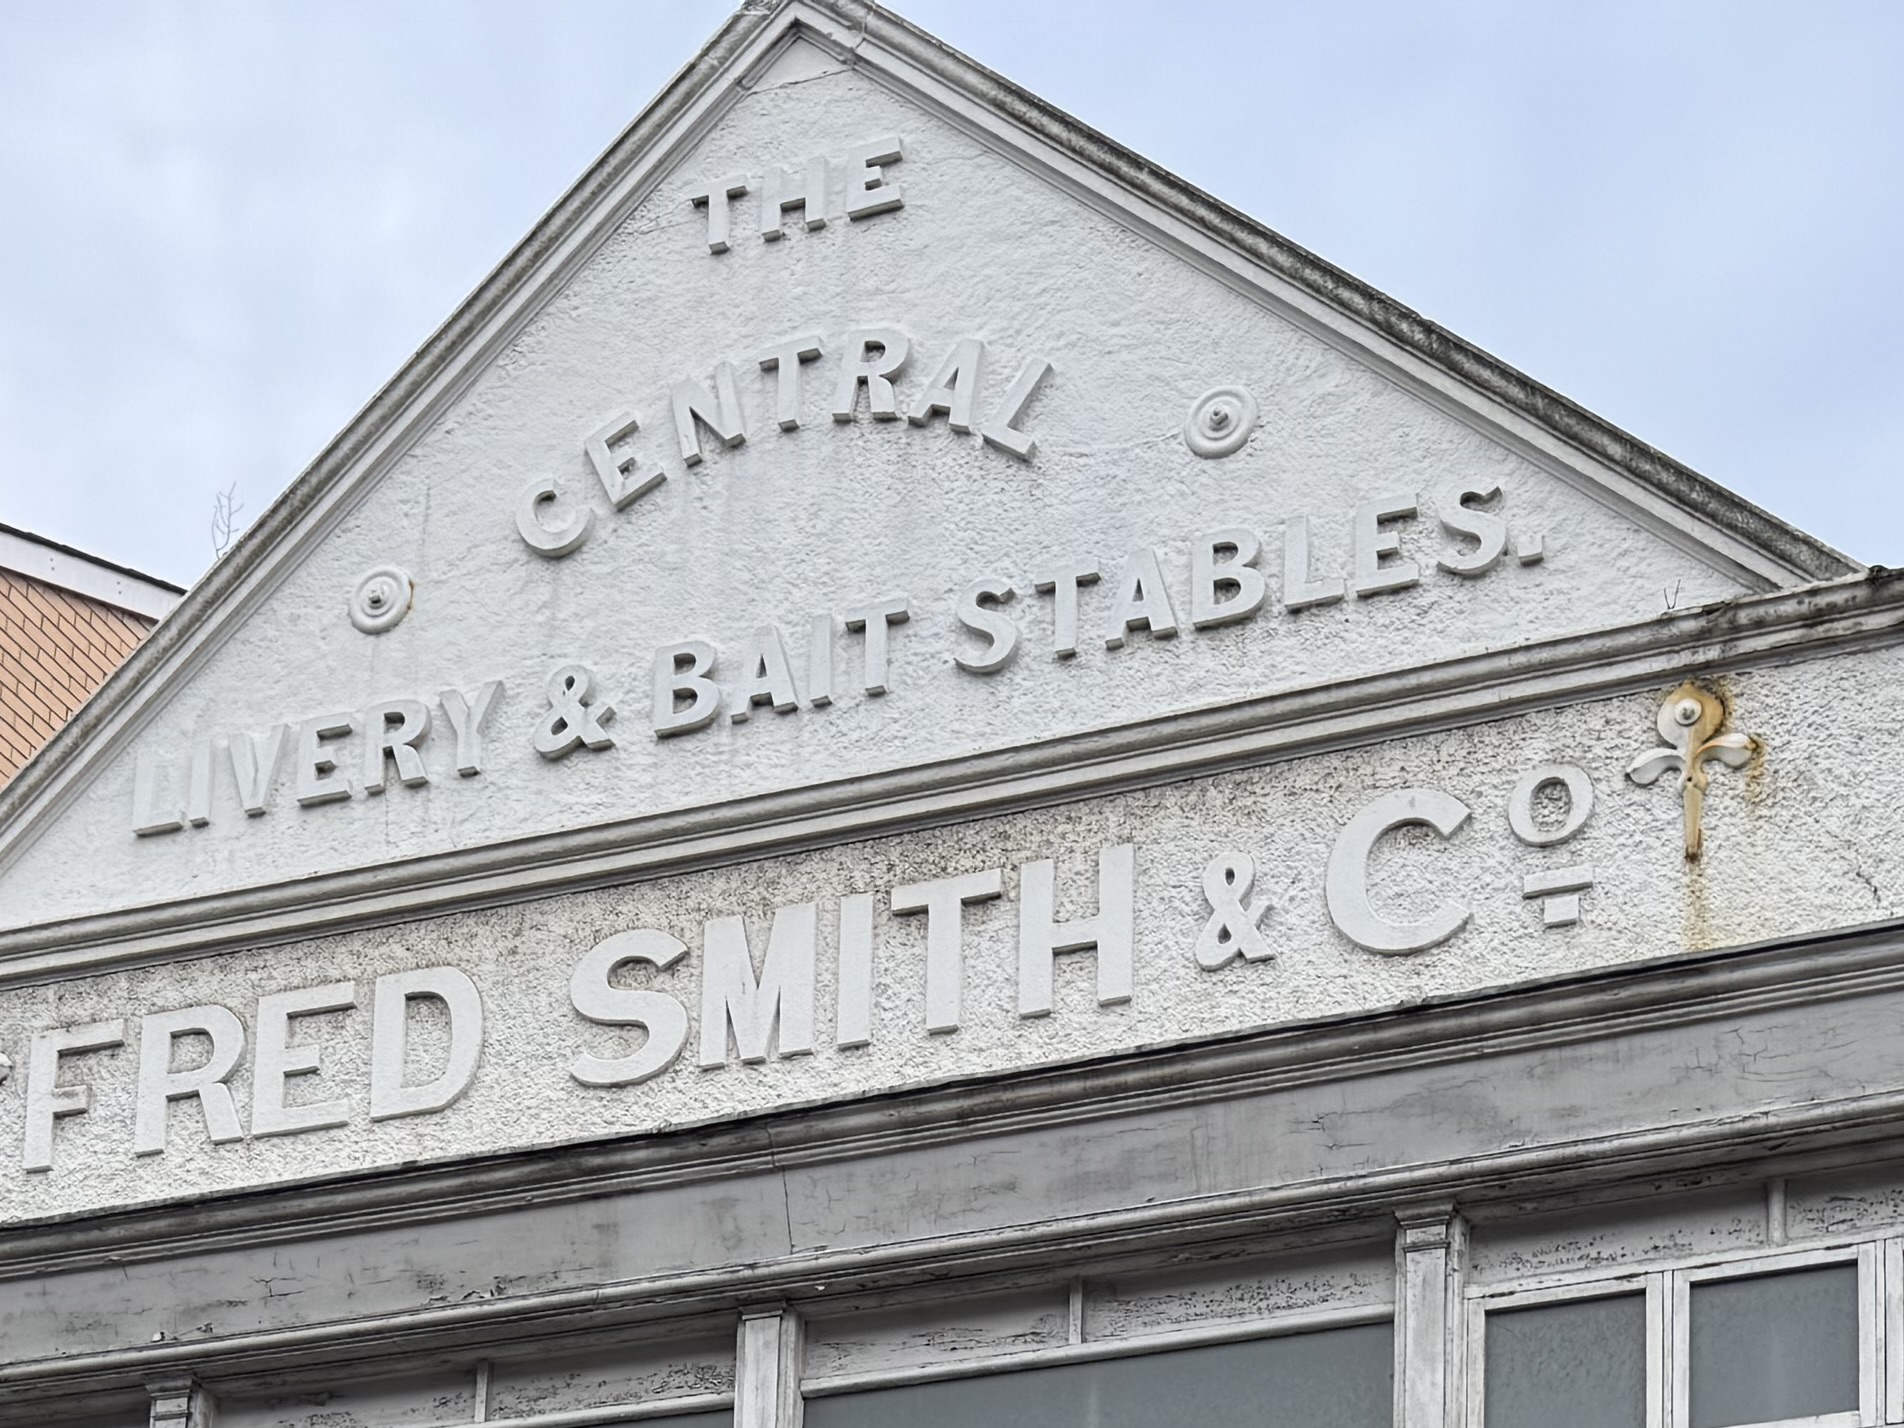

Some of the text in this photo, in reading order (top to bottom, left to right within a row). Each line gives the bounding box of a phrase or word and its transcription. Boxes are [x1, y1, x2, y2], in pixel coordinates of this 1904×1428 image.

[692, 135, 906, 254] THE
[514, 325, 1055, 559] CENTRAL
[132, 484, 1547, 836] LIVERY & BAIT STABLES.
[22, 964, 484, 1173] FRED
[569, 844, 1135, 1088] SMITH
[1196, 851, 1277, 972] &
